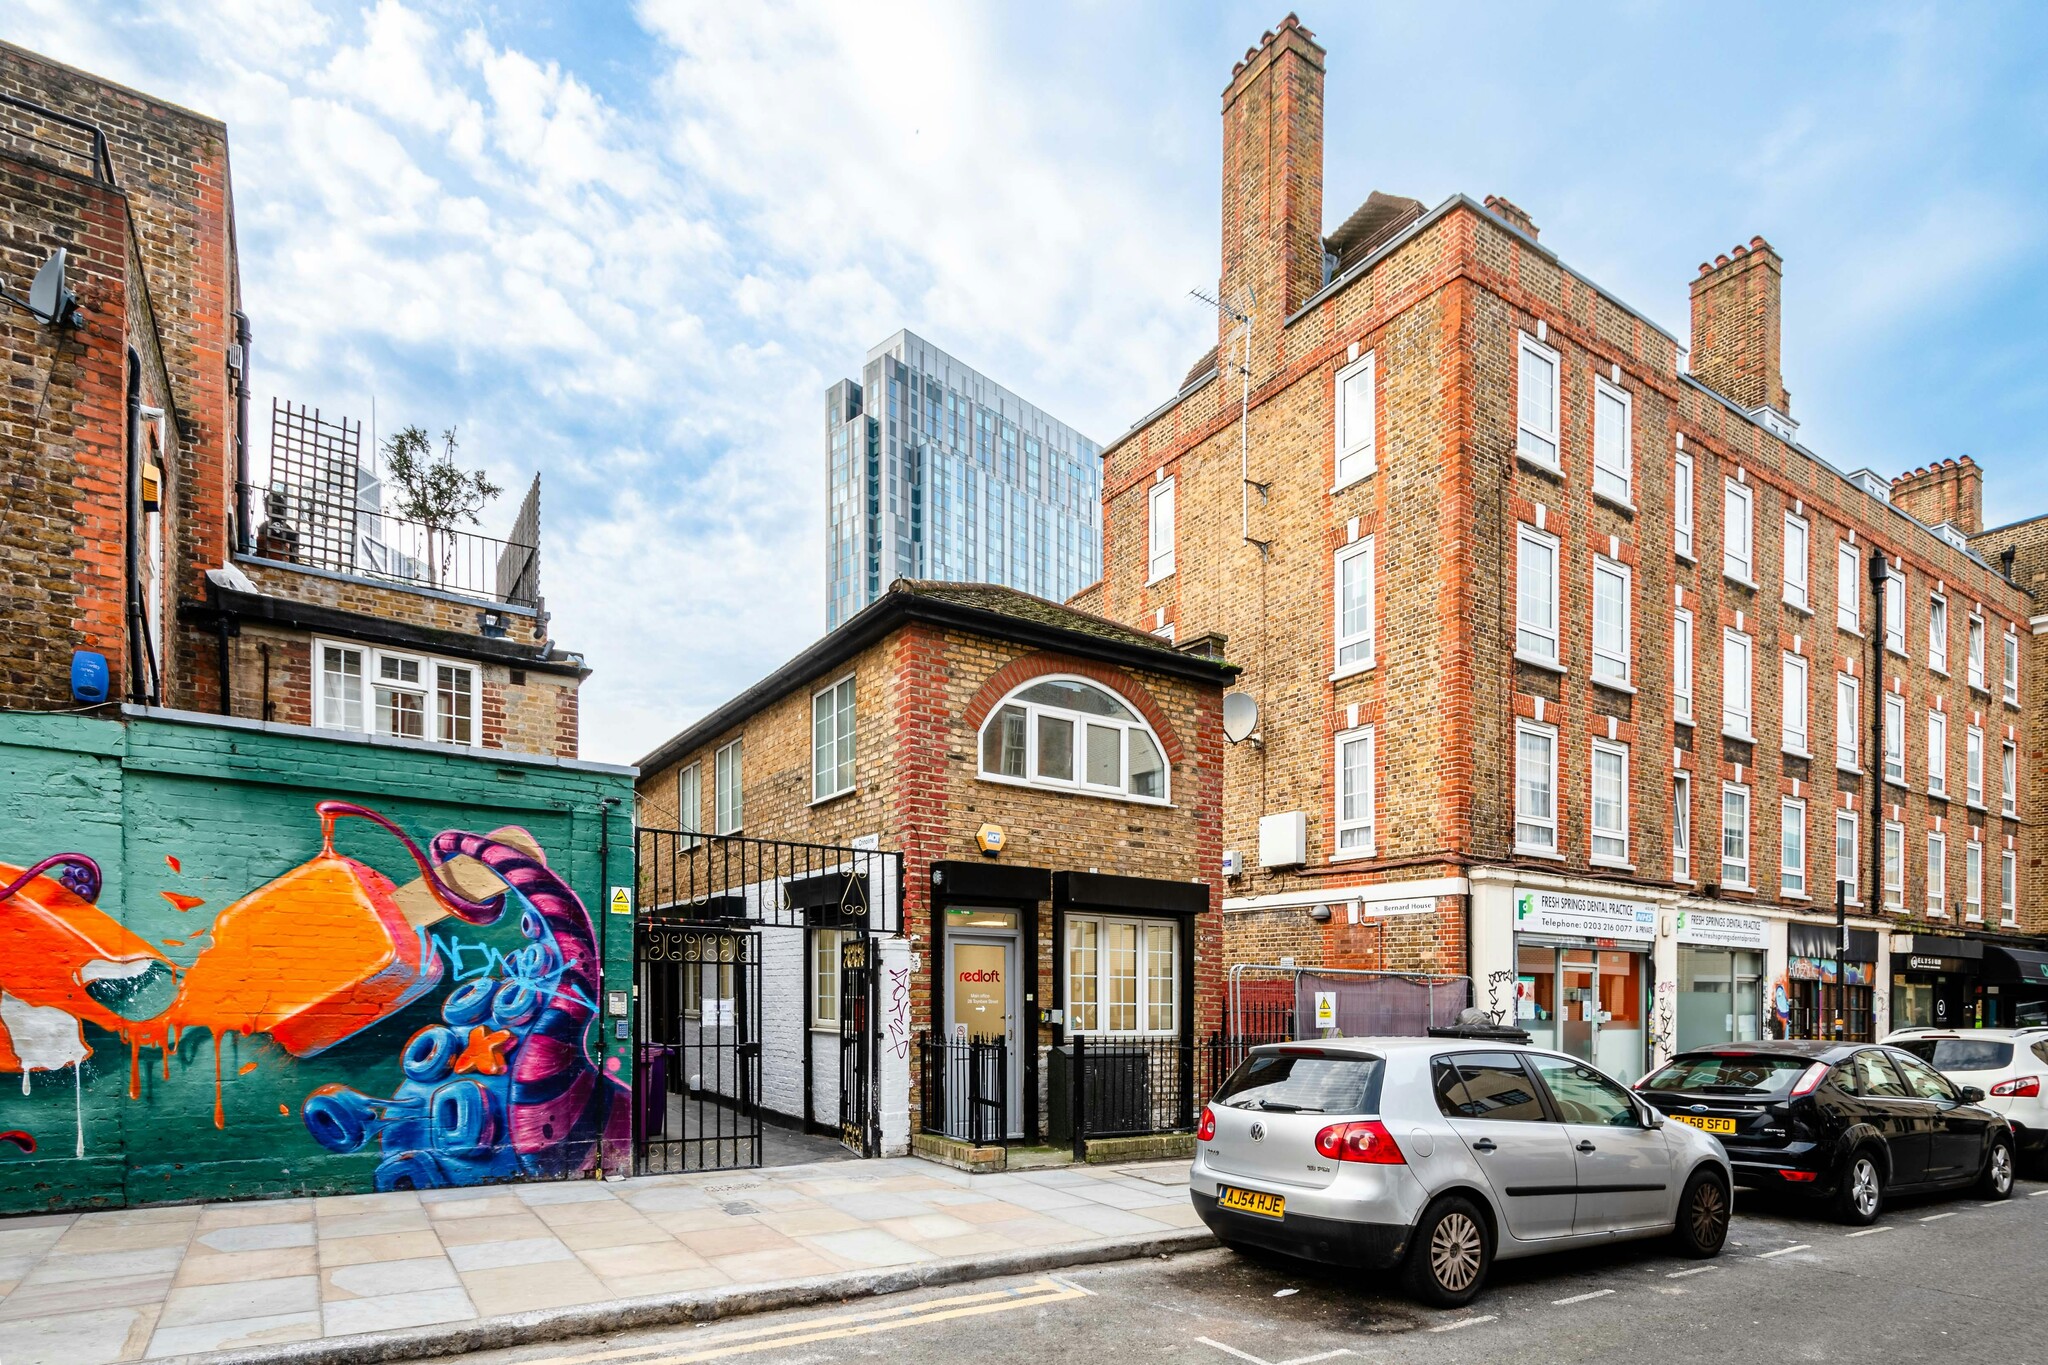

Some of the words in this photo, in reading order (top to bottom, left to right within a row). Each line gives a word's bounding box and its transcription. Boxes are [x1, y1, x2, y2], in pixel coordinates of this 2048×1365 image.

[1383, 903, 1410, 912] Bernard
[1411, 902, 1432, 910] House
[1541, 895, 1560, 909] FRESH
[1561, 897, 1586, 912] SPRINGS
[1587, 899, 1608, 914] DENTAL
[1609, 902, 1633, 916] PRACTICE
[1541, 917, 1582, 929] Telephone:
[1583, 921, 1602, 931] 0203
[1603, 922, 1614, 932] 216
[1615, 924, 1633, 933] 0077
[1636, 913, 1653, 922] NHS
[1691, 914, 1705, 926] FRESH
[1705, 915, 1726, 928] SPRINGS
[1726, 917, 1743, 929] DENTAL
[1743, 919, 1761, 931] PRACTICE
[959, 969, 1001, 983] redloft
[1707, 1118, 1730, 1131] SFO
[1226, 1189, 1255, 1209] AJ54
[1257, 1193, 1283, 1213] HJE
